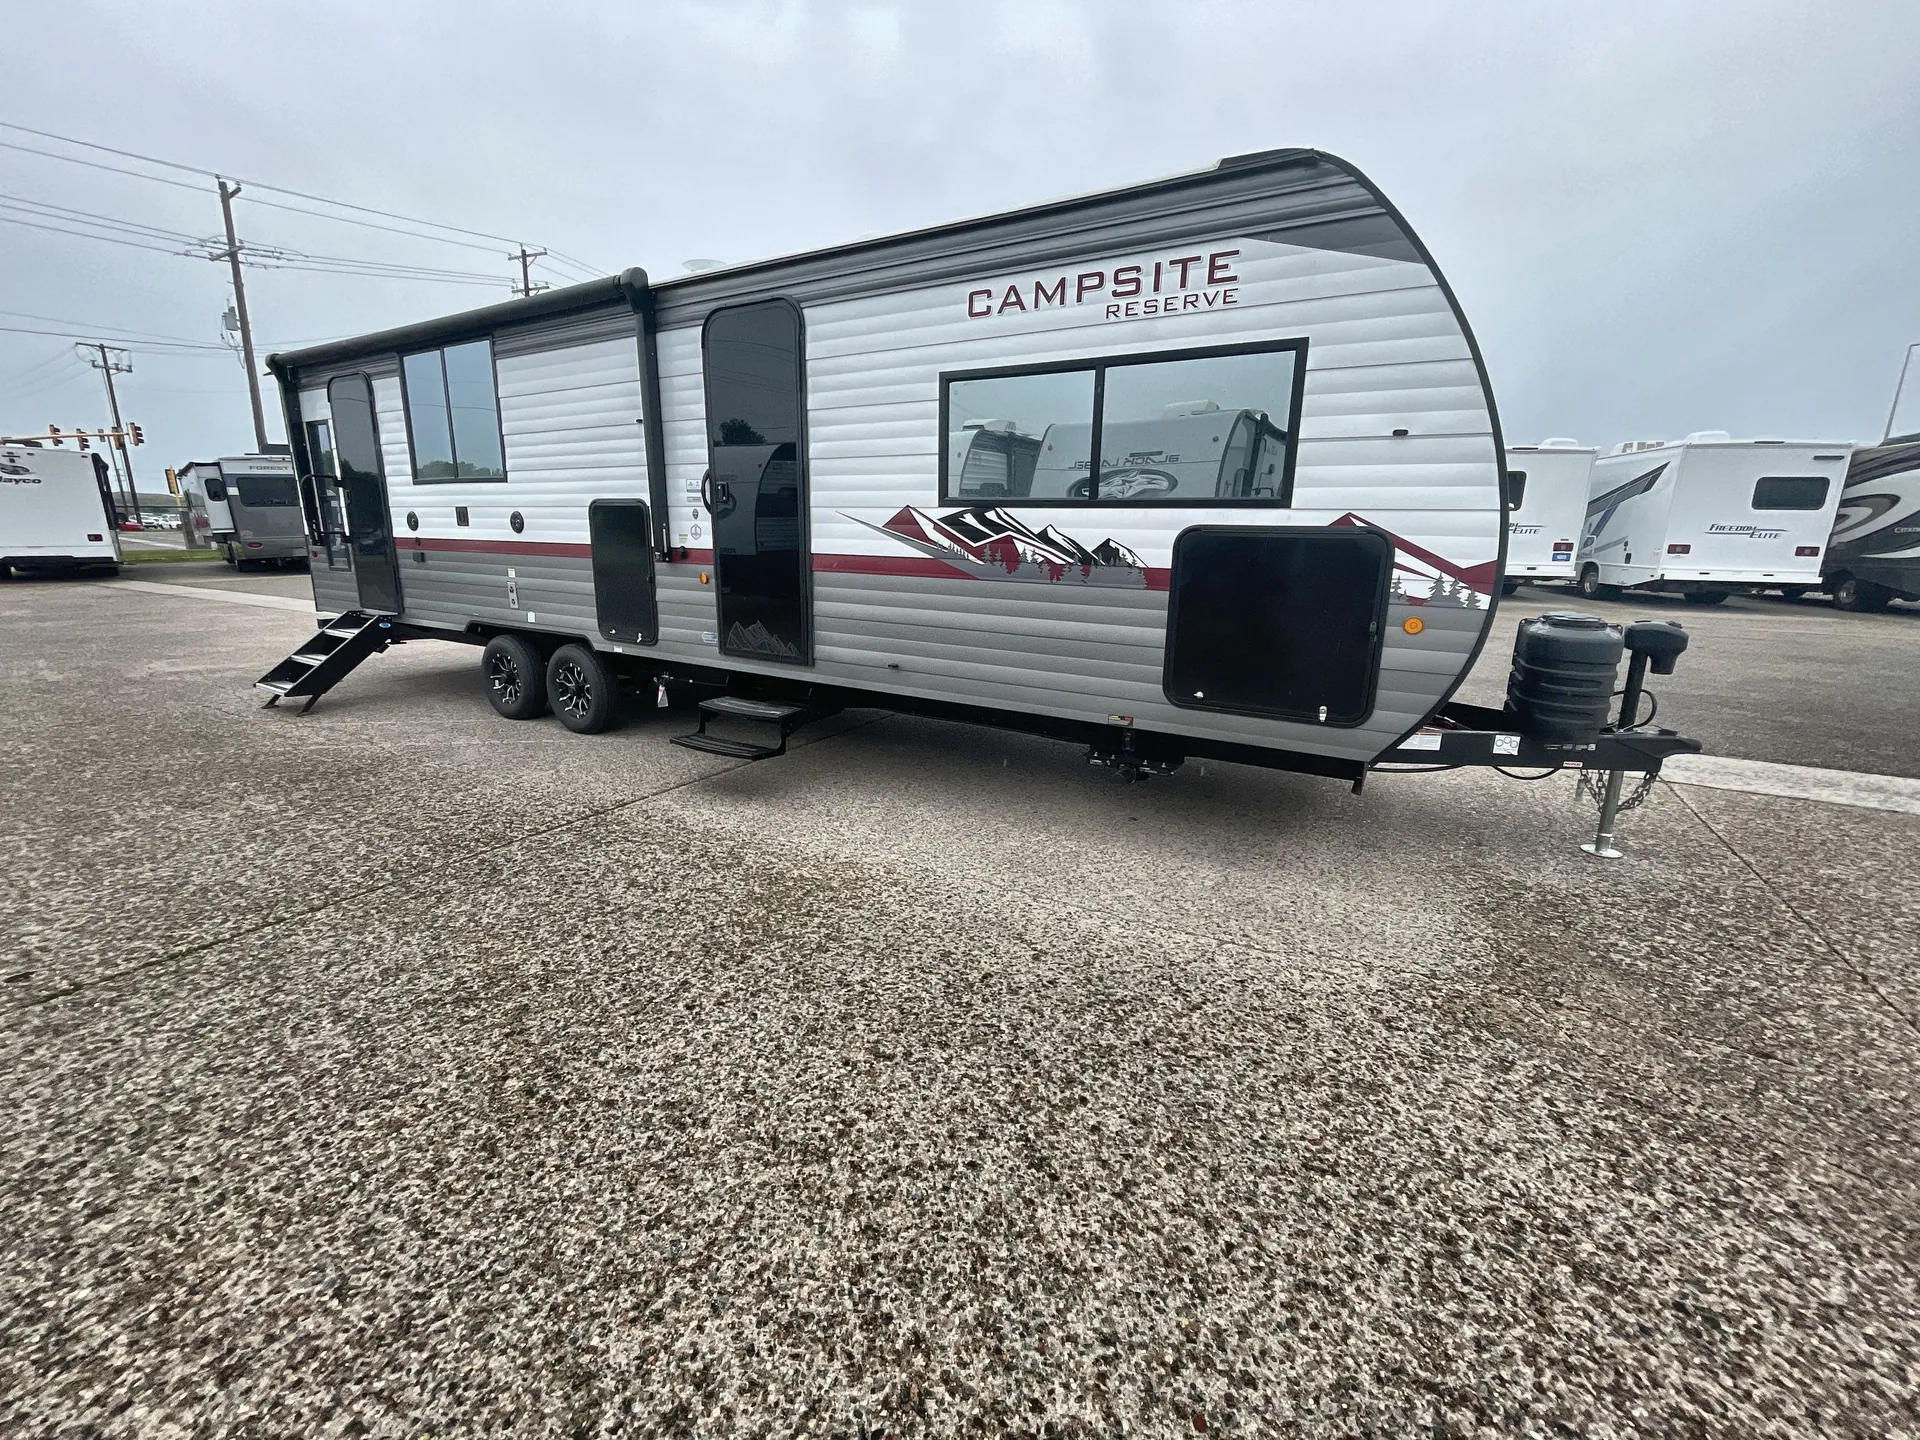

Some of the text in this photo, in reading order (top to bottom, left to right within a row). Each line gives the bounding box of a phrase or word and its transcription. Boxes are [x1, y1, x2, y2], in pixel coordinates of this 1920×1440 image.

[967, 249, 1241, 318] CAMPSITE
[1105, 288, 1240, 319] RESERVE
[1709, 523, 1758, 531] FREEDOM
[1749, 531, 1782, 539] ELITE
